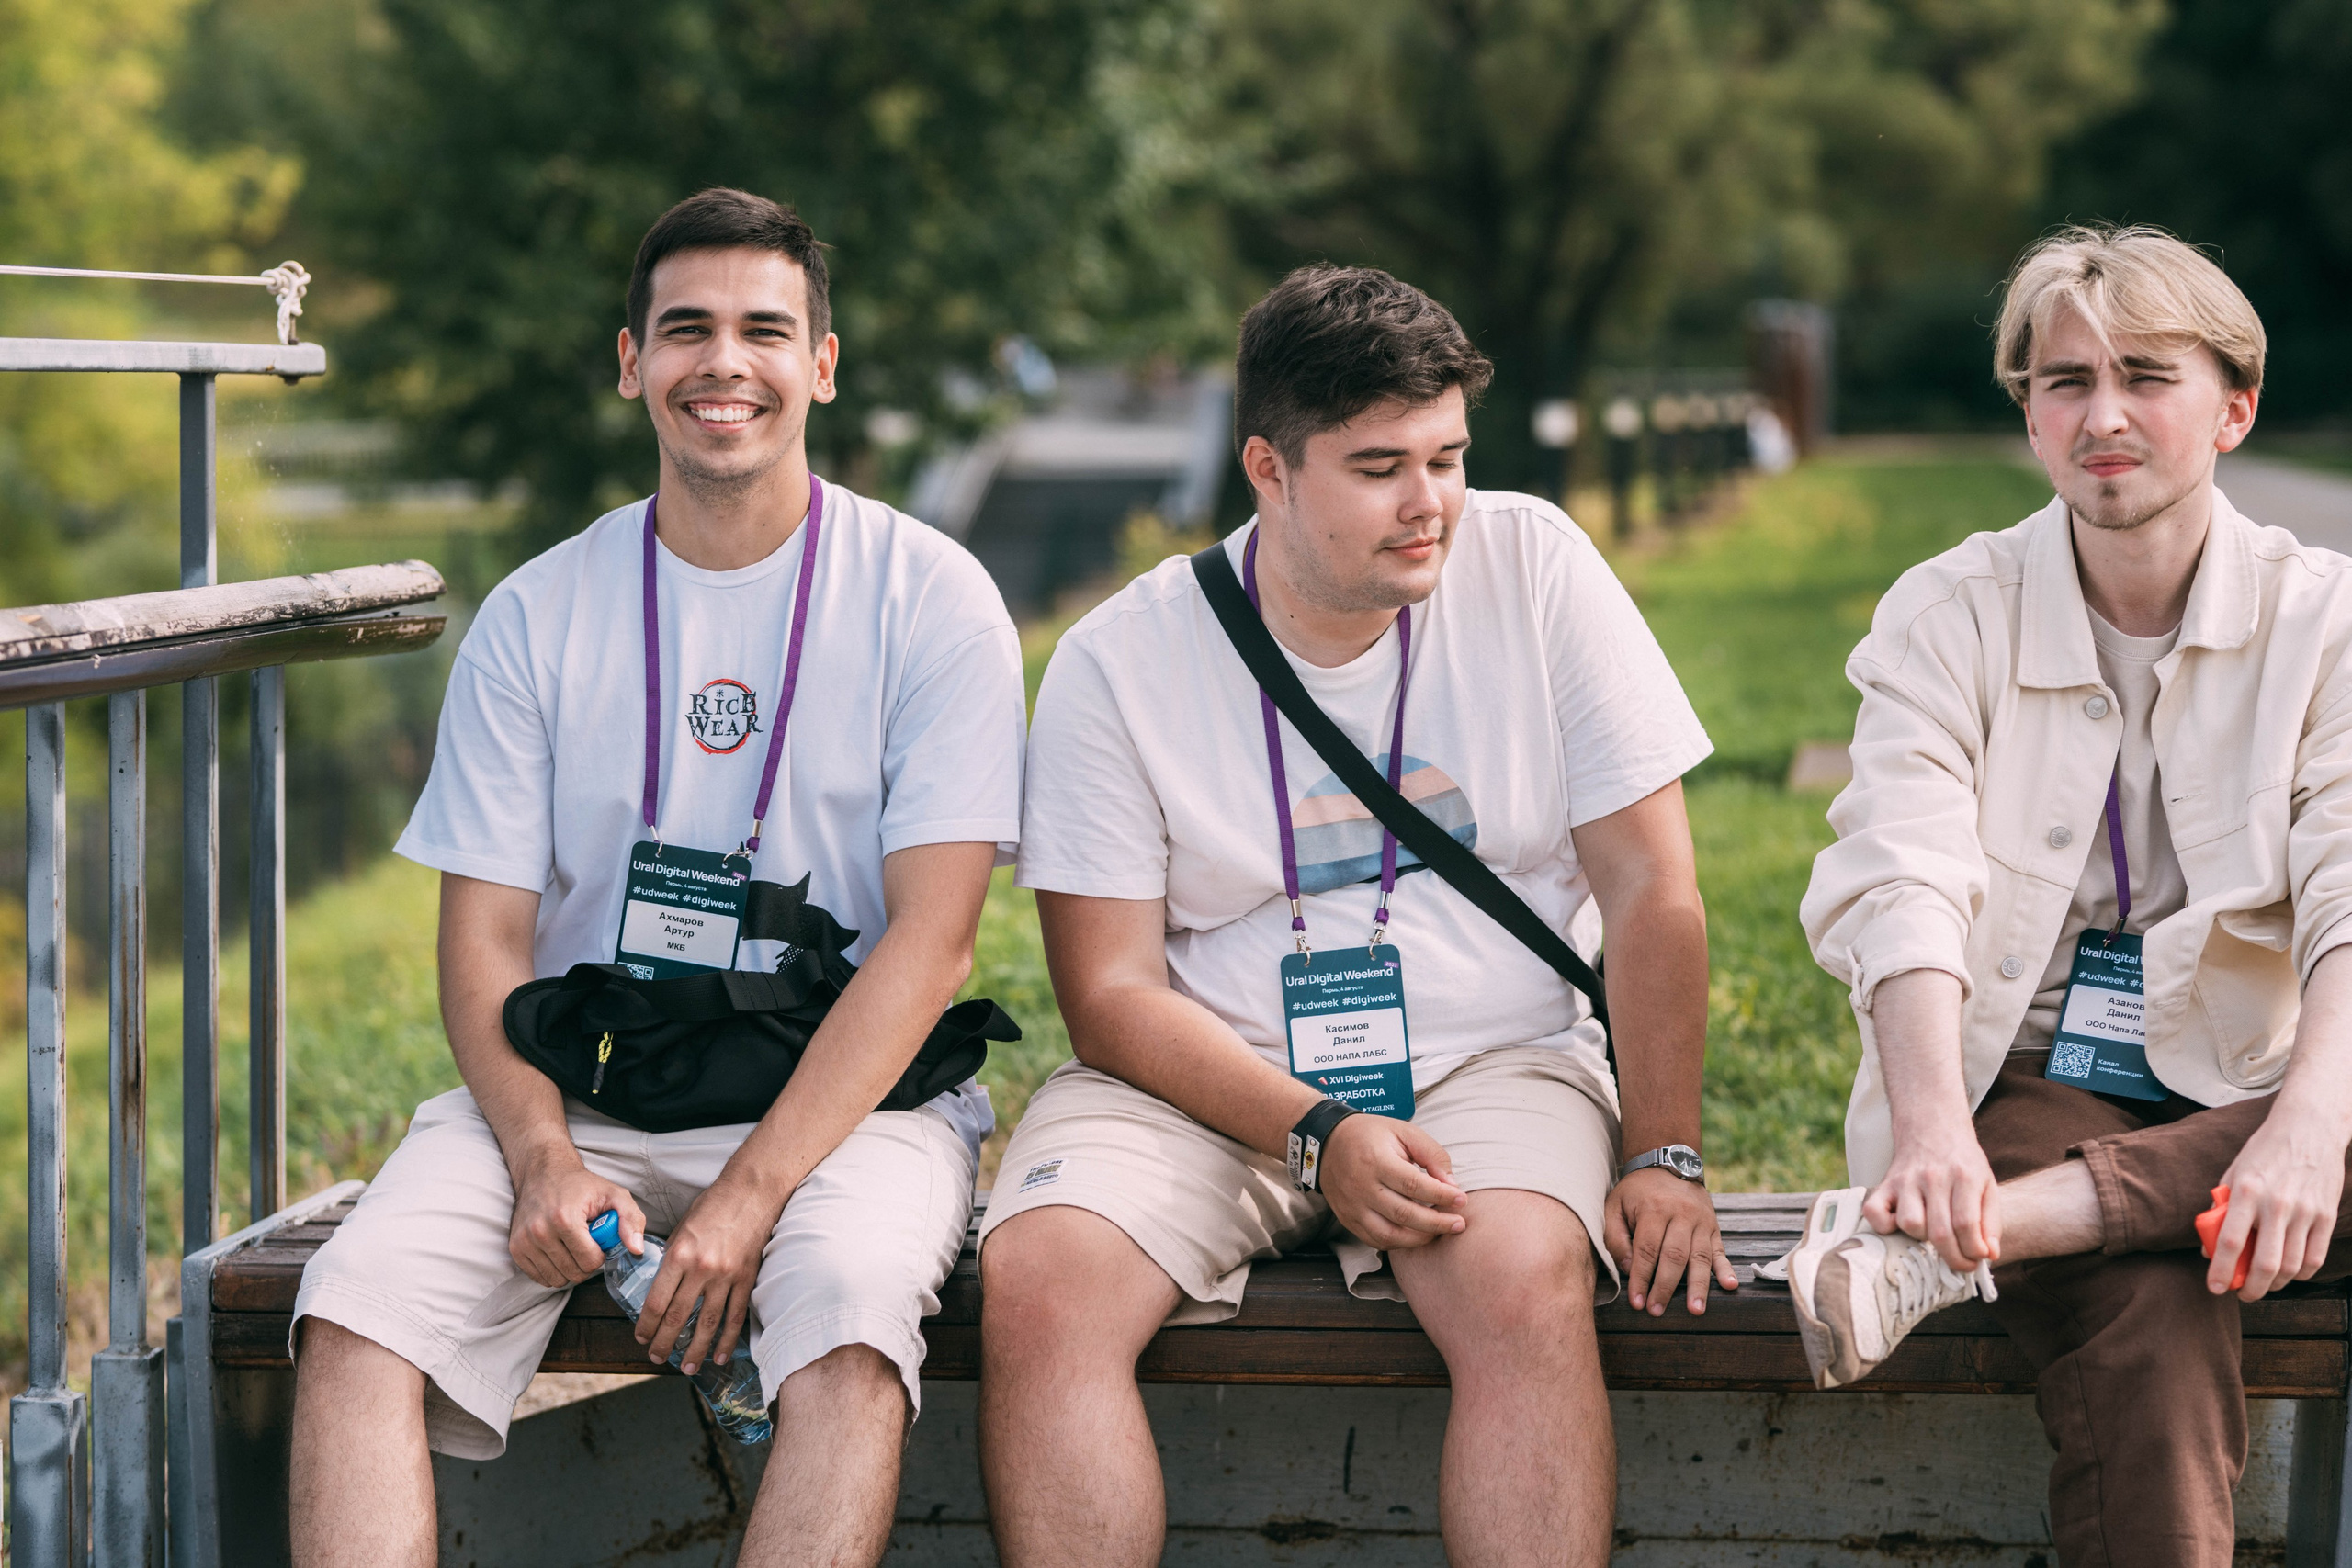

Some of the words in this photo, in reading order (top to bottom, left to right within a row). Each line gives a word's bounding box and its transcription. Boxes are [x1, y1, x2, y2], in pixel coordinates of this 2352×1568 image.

[684, 714, 764, 738] WEAR
[633, 860, 655, 873] Ural
[656, 863, 690, 878] Digital
[691, 870, 740, 887] Weekend
[633, 886, 679, 901] #udweek
[682, 894, 737, 910] #digiweek
[659, 911, 704, 927] Ахмаров
[663, 925, 695, 939] Артур
[667, 942, 685, 952] МКБ
[2080, 946, 2102, 958] Ural
[2103, 951, 2138, 964] Digital
[1285, 975, 1307, 987] Ural
[1308, 971, 1343, 987] Digital
[1343, 966, 1394, 979] Weekend
[2078, 970, 2126, 986] #udweek
[1292, 998, 1339, 1011] #udweek
[1342, 992, 1396, 1006] #digiweek
[2108, 997, 2145, 1010] Азанов
[2106, 1009, 2141, 1021] Данил
[1325, 1022, 1369, 1033] Касимов
[2086, 1020, 2106, 1029] ООО
[2108, 1023, 2130, 1033] Напа
[1332, 1035, 1365, 1047] Данил
[1314, 1055, 1334, 1064] ООО
[1336, 1052, 1361, 1061] НАПА
[1363, 1049, 1387, 1058] ЛАБС
[2098, 1058, 2120, 1067] Канал
[1345, 1072, 1384, 1084] Digiweek
[2096, 1066, 2143, 1078] конференции
[1366, 1104, 1395, 1112] TAGLINE
